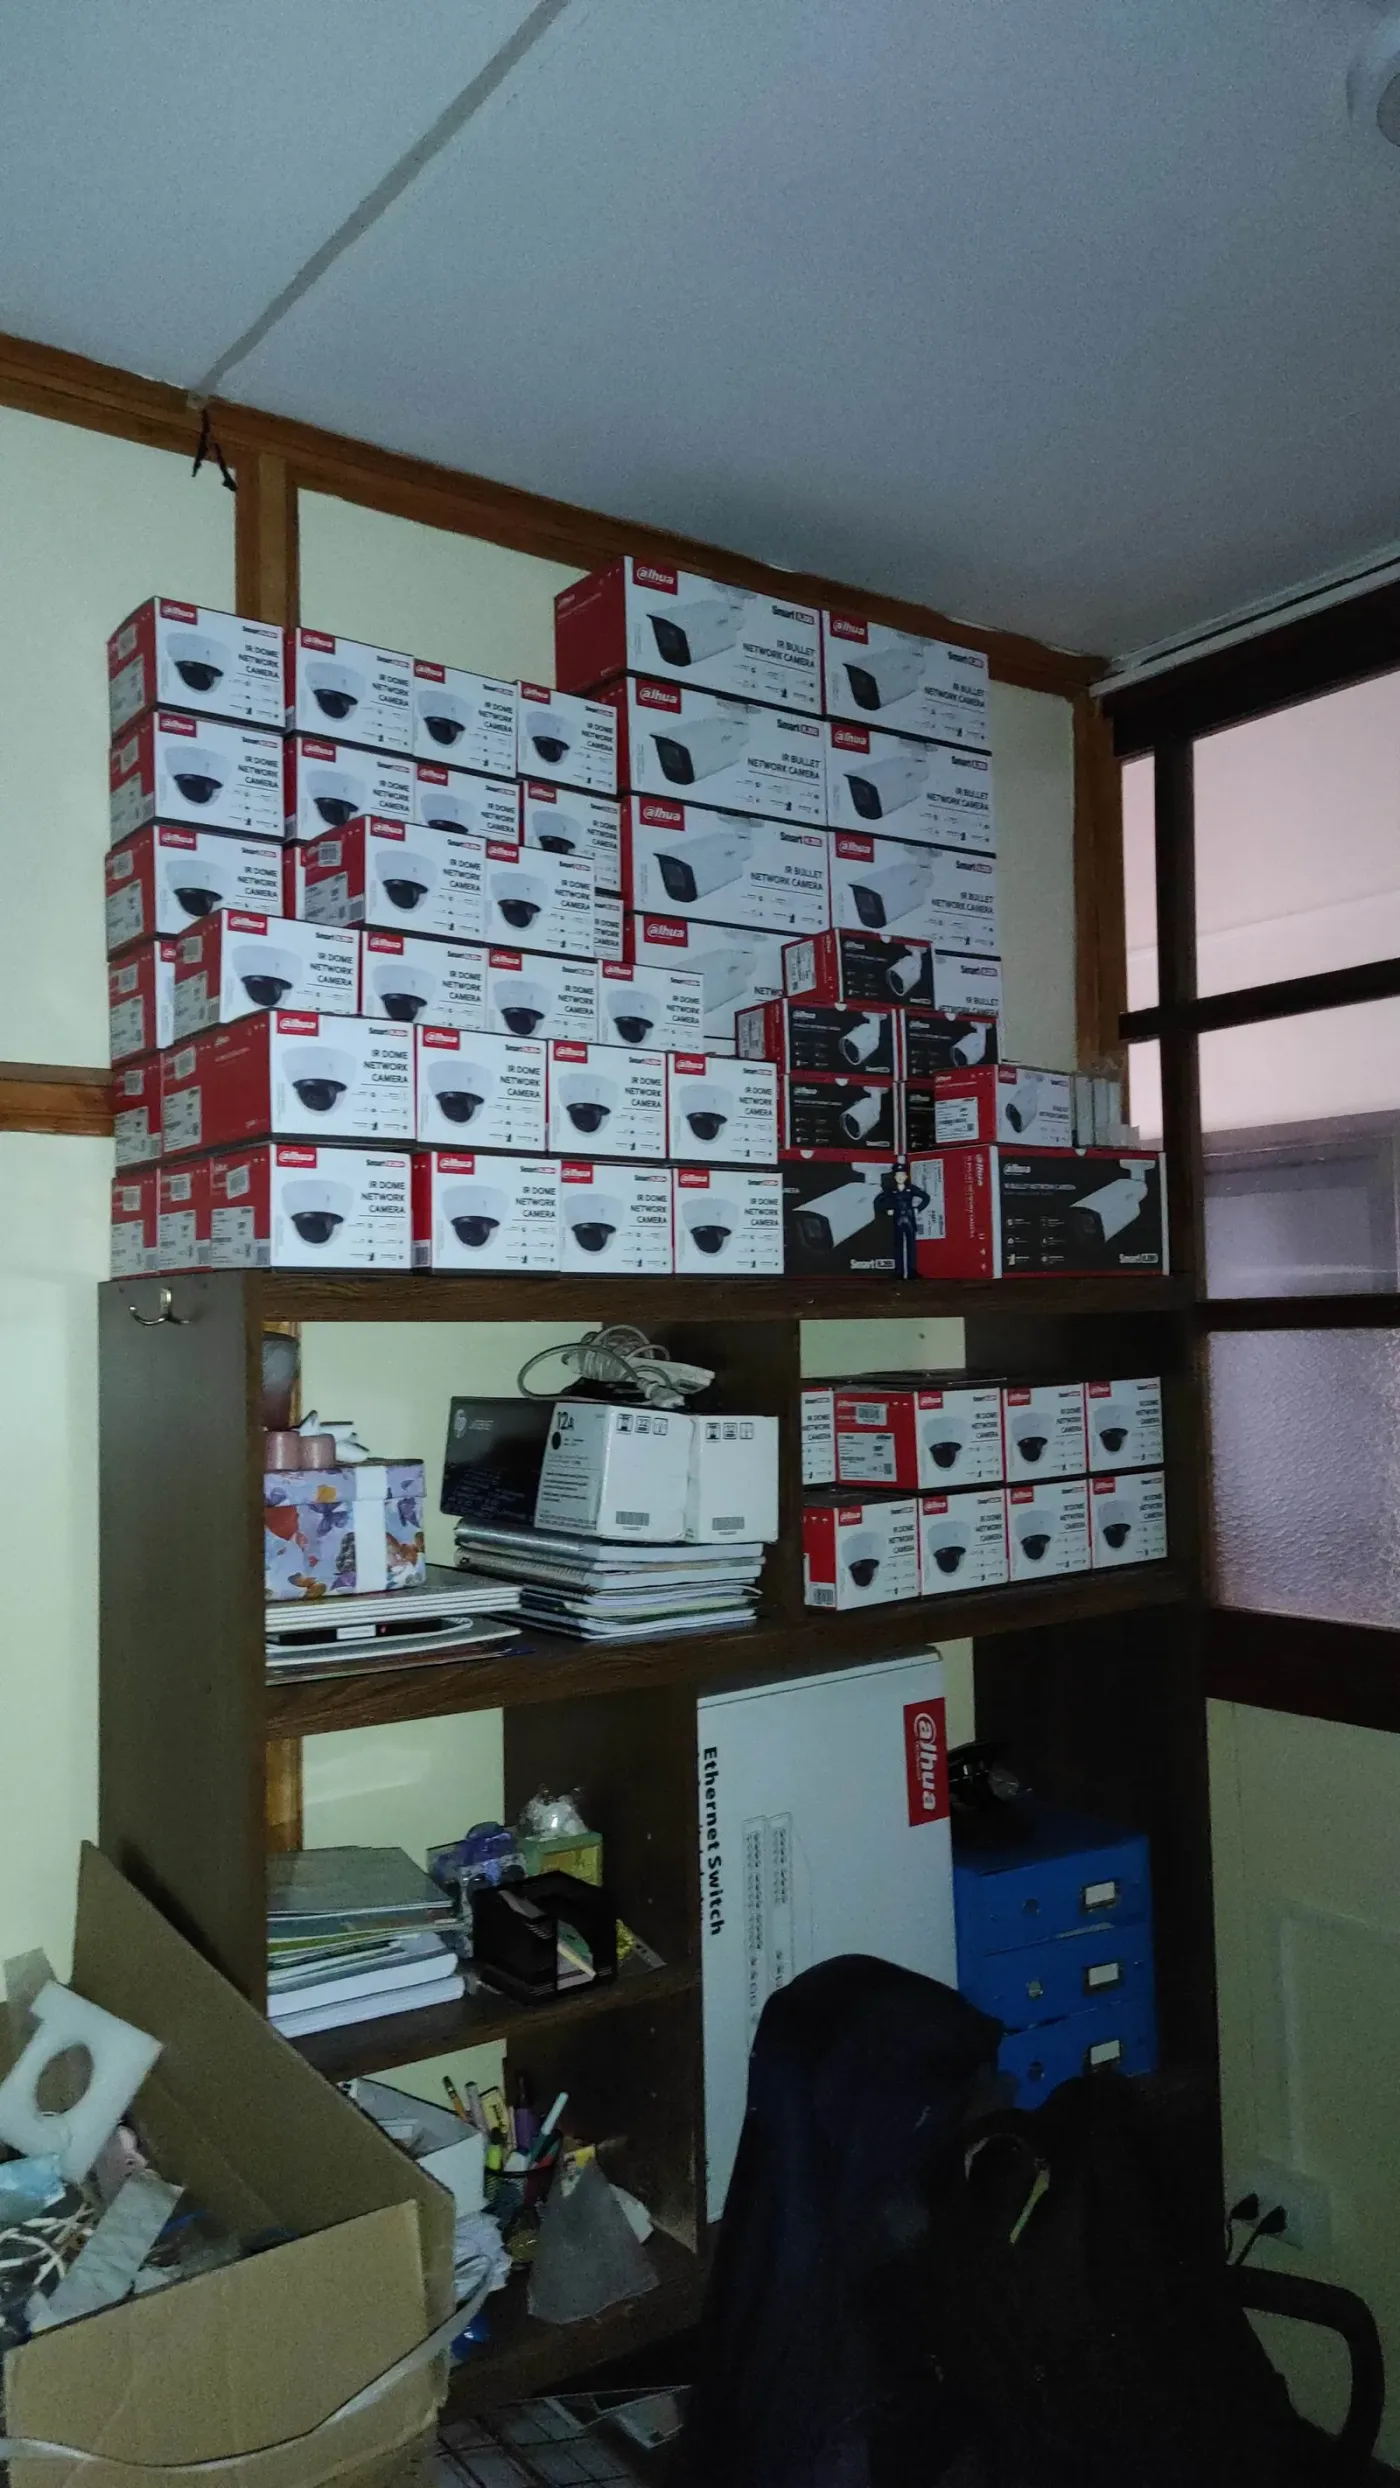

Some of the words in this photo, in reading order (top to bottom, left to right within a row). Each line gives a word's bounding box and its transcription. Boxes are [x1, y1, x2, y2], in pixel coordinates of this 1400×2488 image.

[743, 642, 784, 660] NETWORK
[785, 653, 816, 668] CAMERA
[786, 642, 815, 657] BULLET
[924, 686, 958, 702] NETWORK
[959, 695, 986, 708] CAMERA
[961, 685, 985, 698] BULLET
[791, 755, 821, 769] BULLET
[747, 758, 788, 774] NETWORK
[789, 766, 821, 780] CAMERA
[964, 789, 988, 800] BULLET
[928, 793, 962, 806] NETWORK
[963, 799, 989, 811] CAMERA
[459, 860, 481, 871] DOME
[444, 868, 481, 882] NETWORK
[794, 867, 823, 879] BULLET
[450, 880, 481, 892] CAMERA
[569, 880, 591, 891] DOME
[751, 872, 791, 886] NETWORK
[792, 878, 823, 891] CAMERA
[555, 888, 591, 901] NETWORK
[969, 893, 996, 904] BULLET
[561, 899, 591, 911] CAMERA
[932, 897, 967, 910] NETWORK
[968, 903, 997, 914] CAMERA
[328, 954, 354, 965] DOME
[310, 962, 353, 976] NETWORK
[317, 974, 353, 987] CAMERA
[458, 971, 482, 982] DOME
[442, 980, 482, 992] NETWORK
[573, 986, 595, 996] DOME
[449, 992, 482, 1003] CAMERA
[558, 994, 595, 1006] NETWORK
[564, 1005, 595, 1016] CAMERA
[382, 1050, 408, 1060] DOME
[364, 1061, 408, 1072] NETWORK
[517, 1066, 541, 1076] DOME
[372, 1073, 408, 1083] CAMERA
[500, 1076, 541, 1088] NETWORK
[640, 1077, 662, 1087] DOME
[507, 1088, 541, 1099] CAMERA
[625, 1087, 662, 1098] NETWORK
[753, 1087, 773, 1096] DOME
[632, 1098, 662, 1109] CAMERA
[740, 1097, 773, 1106] NETWORK
[746, 1107, 773, 1116] CAMERA
[379, 1181, 405, 1190] DOME
[362, 1192, 405, 1202] NETWORK
[532, 1187, 556, 1196] DOME
[516, 1198, 556, 1207] NETWORK
[646, 1195, 667, 1203] DOME
[369, 1204, 405, 1214] CAMERA
[523, 1209, 556, 1219] CAMERA
[631, 1205, 667, 1213] NETWORK
[745, 1208, 779, 1216] NETWORK
[637, 1216, 667, 1224] CAMERA
[704, 1747, 720, 1851] Ethernet
[708, 1856, 724, 1936] Switch
